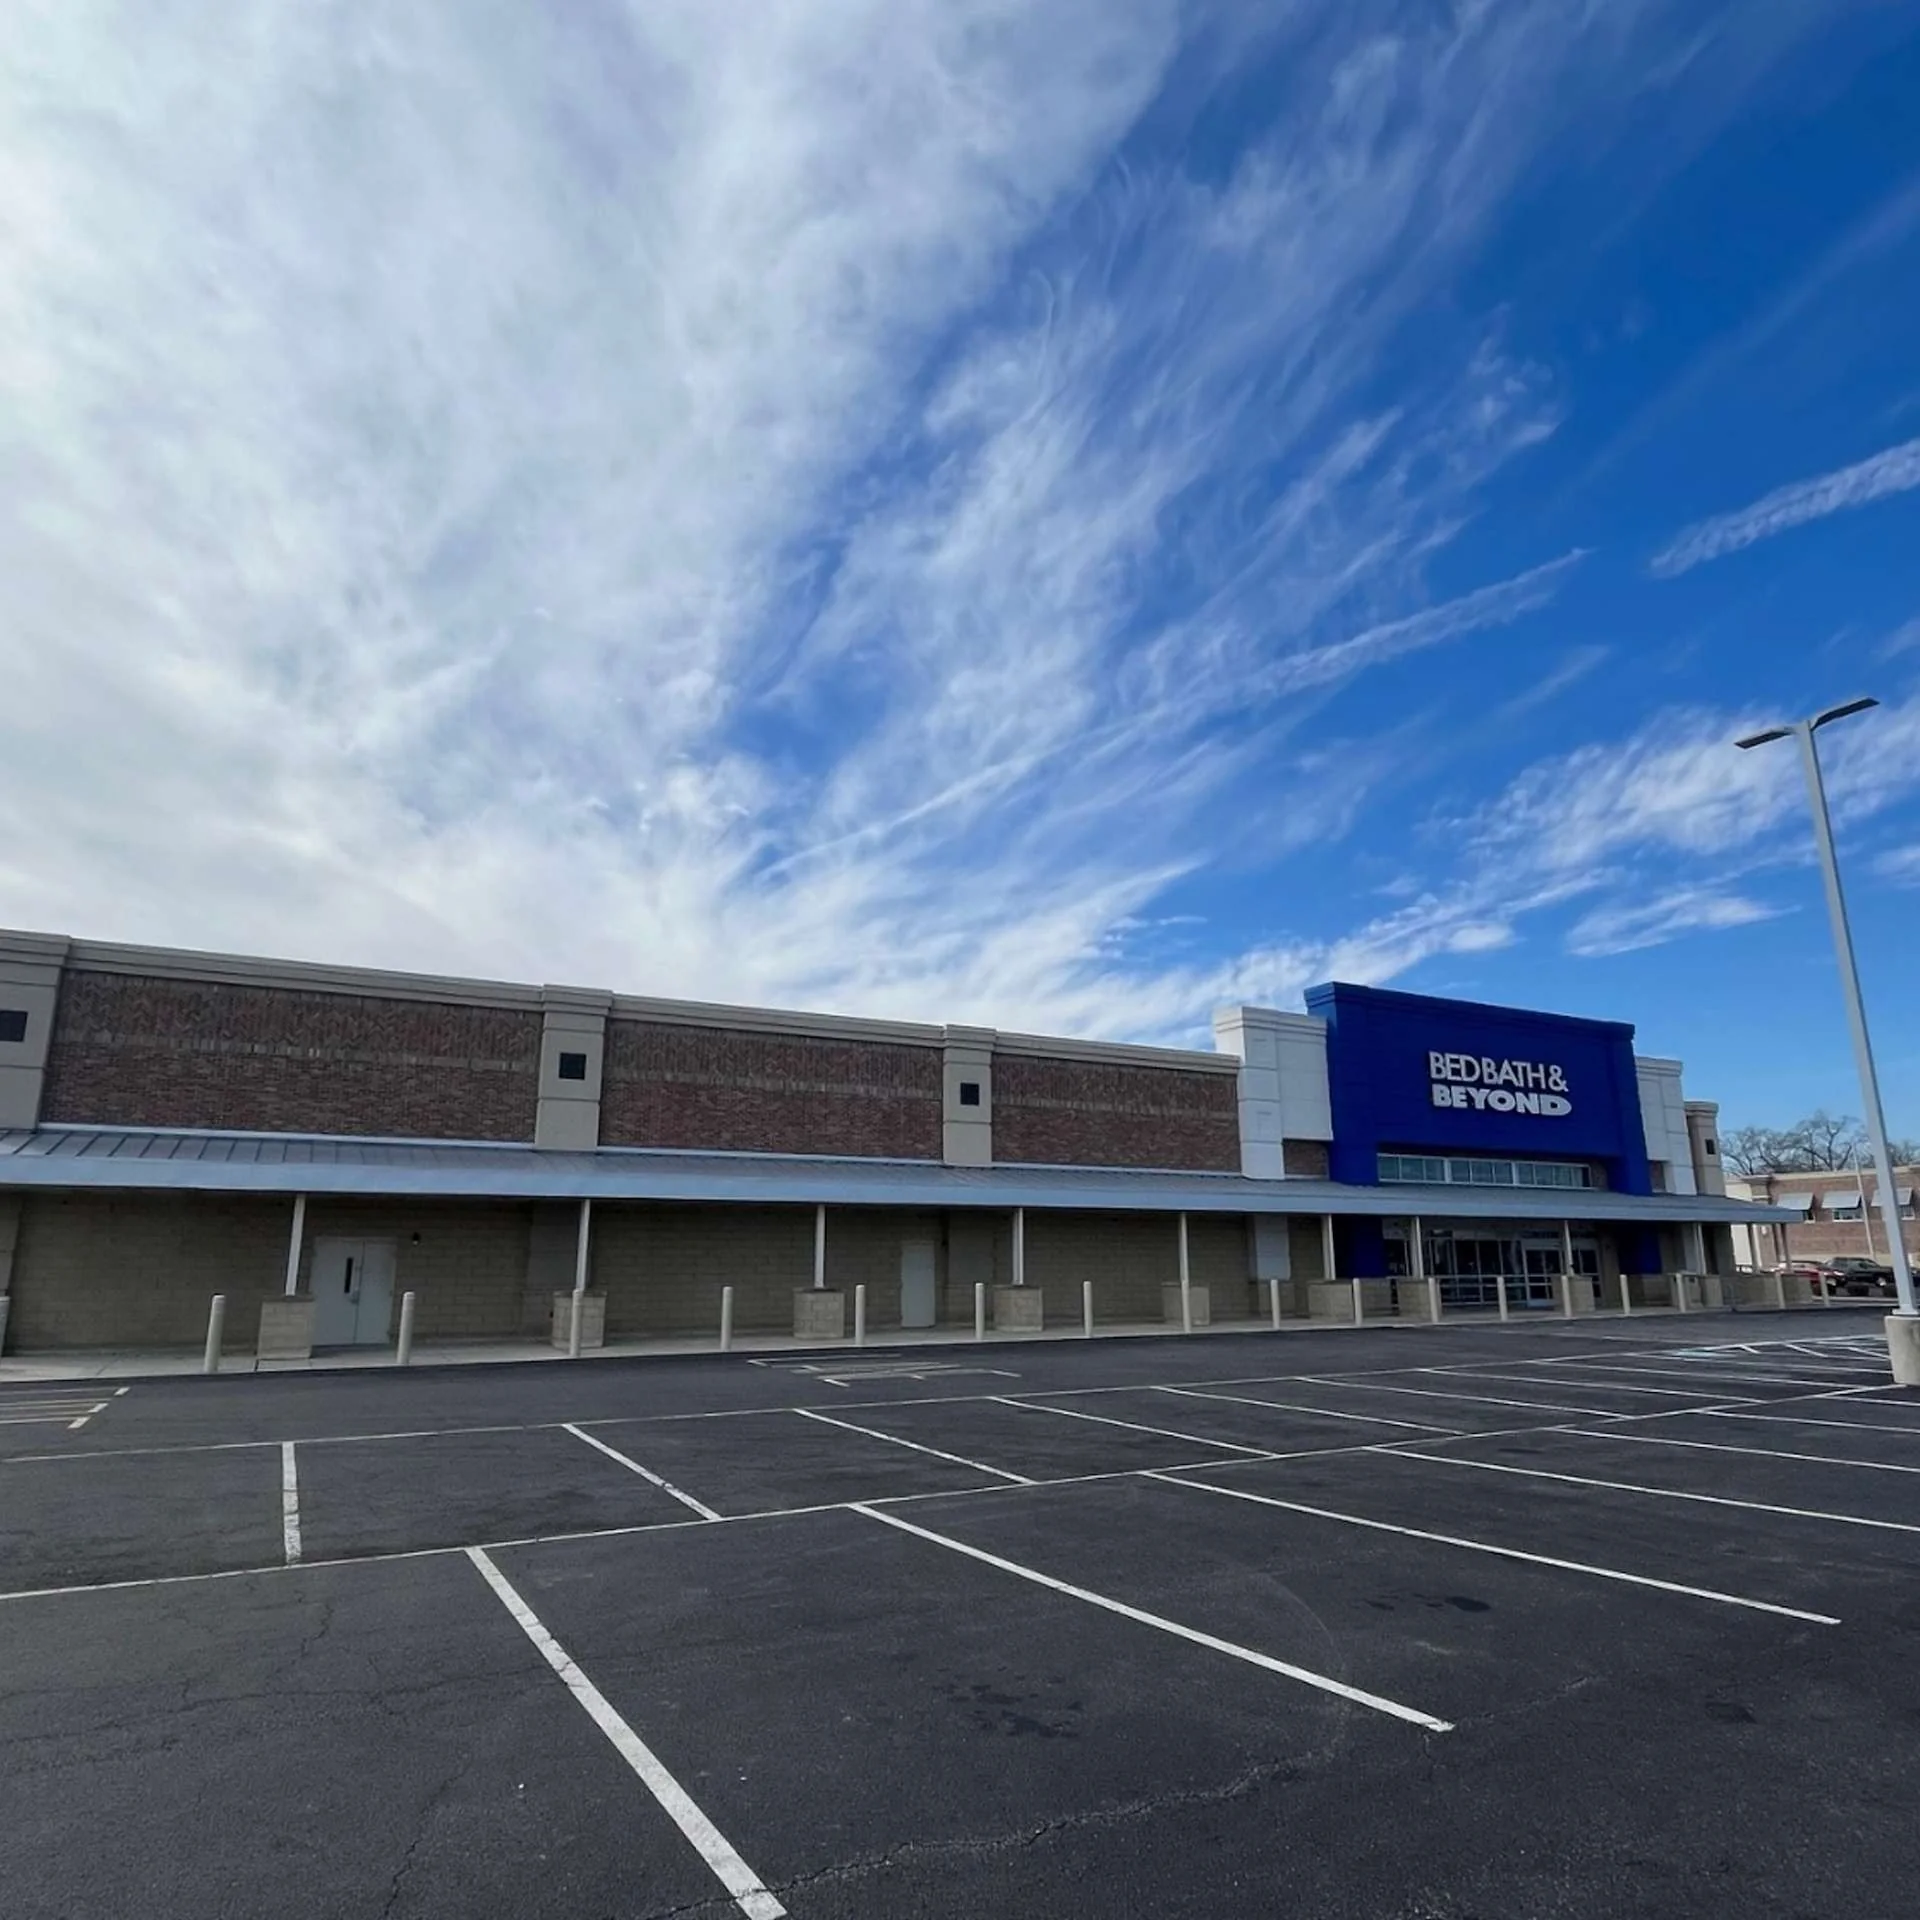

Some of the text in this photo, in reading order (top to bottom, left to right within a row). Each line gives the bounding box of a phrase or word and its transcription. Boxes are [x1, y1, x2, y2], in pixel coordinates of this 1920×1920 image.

[1429, 1051, 1569, 1092] BED BATH &
[1432, 1082, 1573, 1115] BEYOND
